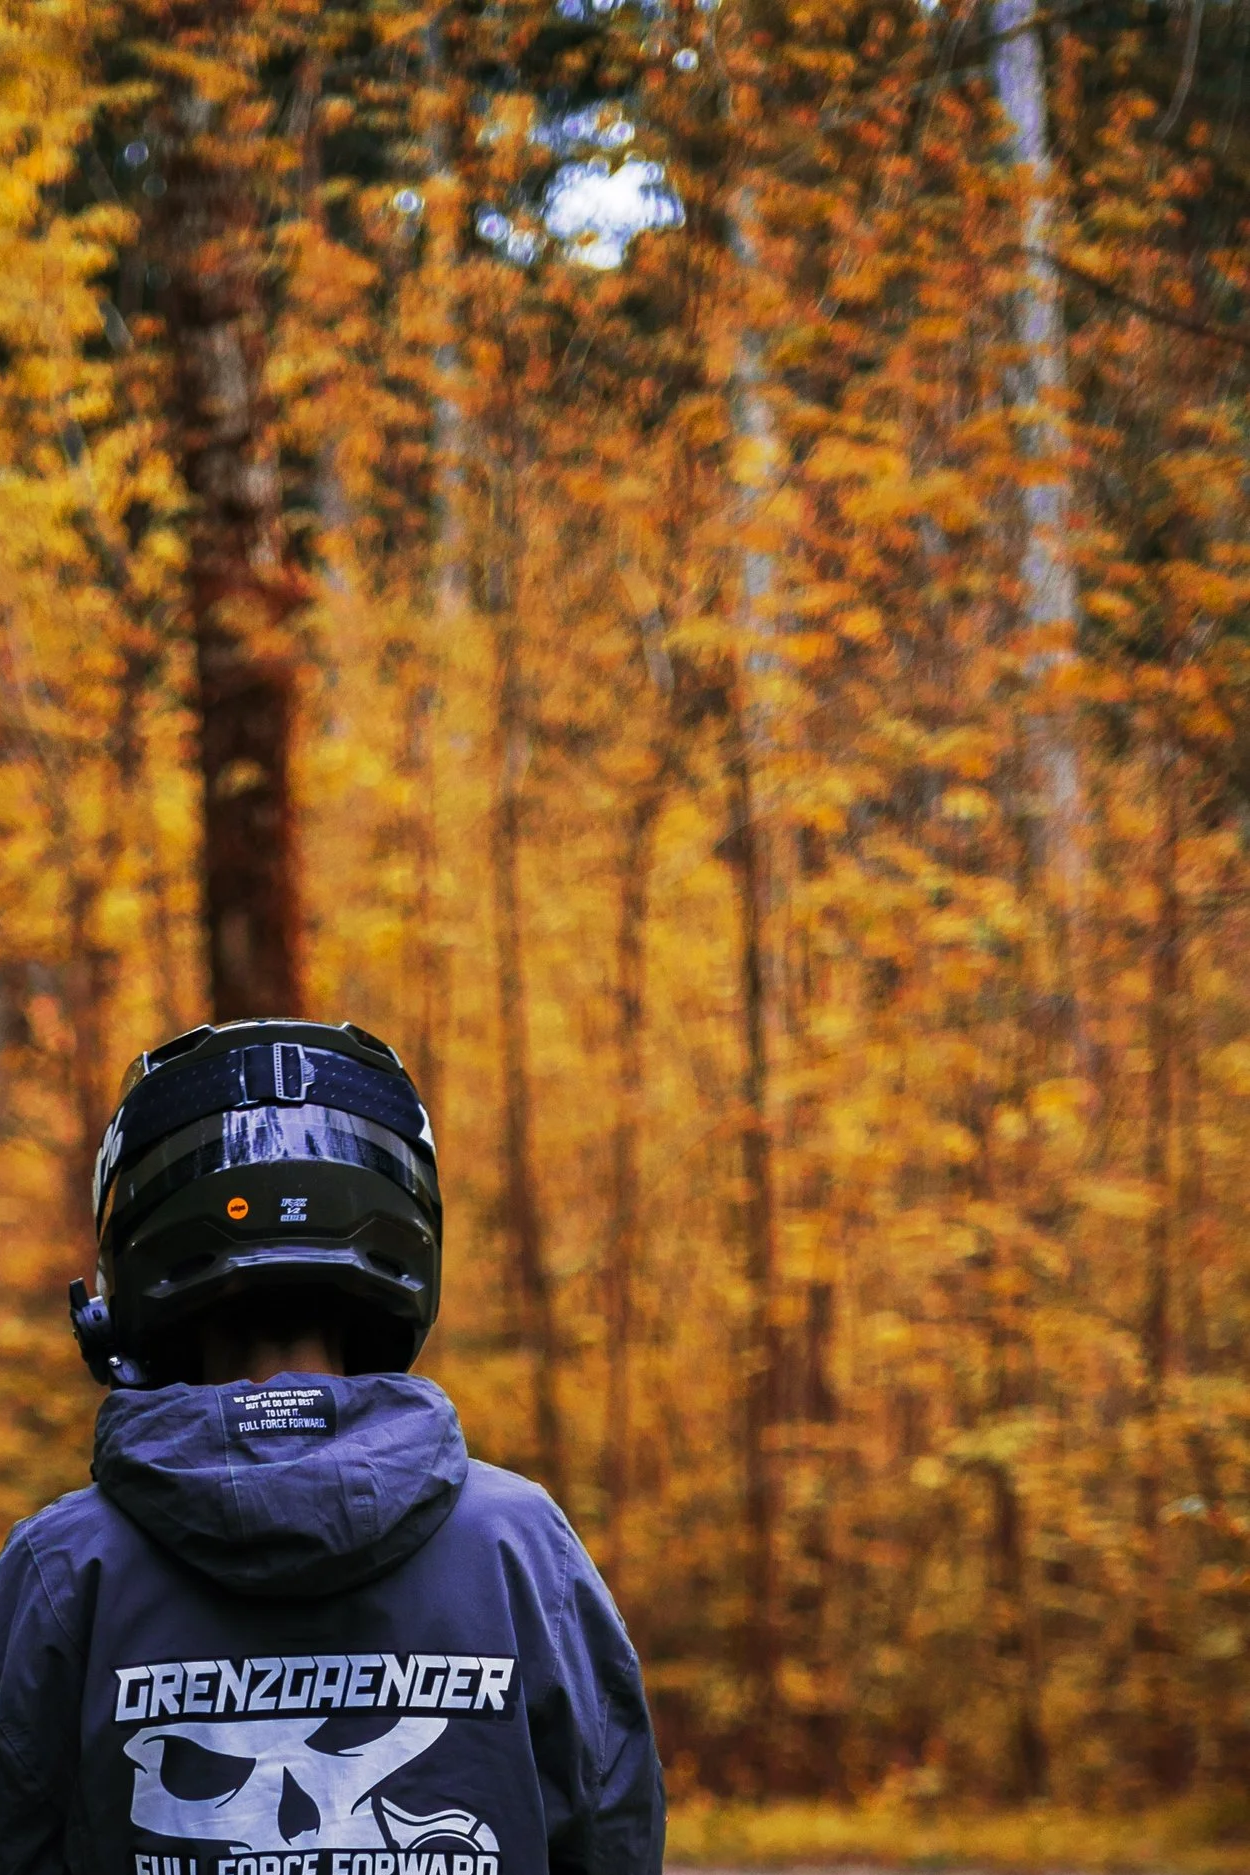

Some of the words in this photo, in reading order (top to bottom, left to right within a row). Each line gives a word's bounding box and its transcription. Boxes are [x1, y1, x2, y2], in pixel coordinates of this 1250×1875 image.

[245, 1402, 259, 1410] BUT
[260, 1400, 272, 1408] WE
[272, 1399, 282, 1407] DO
[283, 1398, 297, 1407] OUR
[298, 1398, 314, 1406] BEST
[265, 1409, 275, 1418] TO
[276, 1409, 291, 1417] LIVE
[292, 1408, 301, 1417] IT.
[238, 1421, 260, 1433] FULL
[260, 1418, 287, 1430] FORCE
[288, 1418, 327, 1429] FORWARD.
[114, 1653, 515, 1722] GRENZGAENGER
